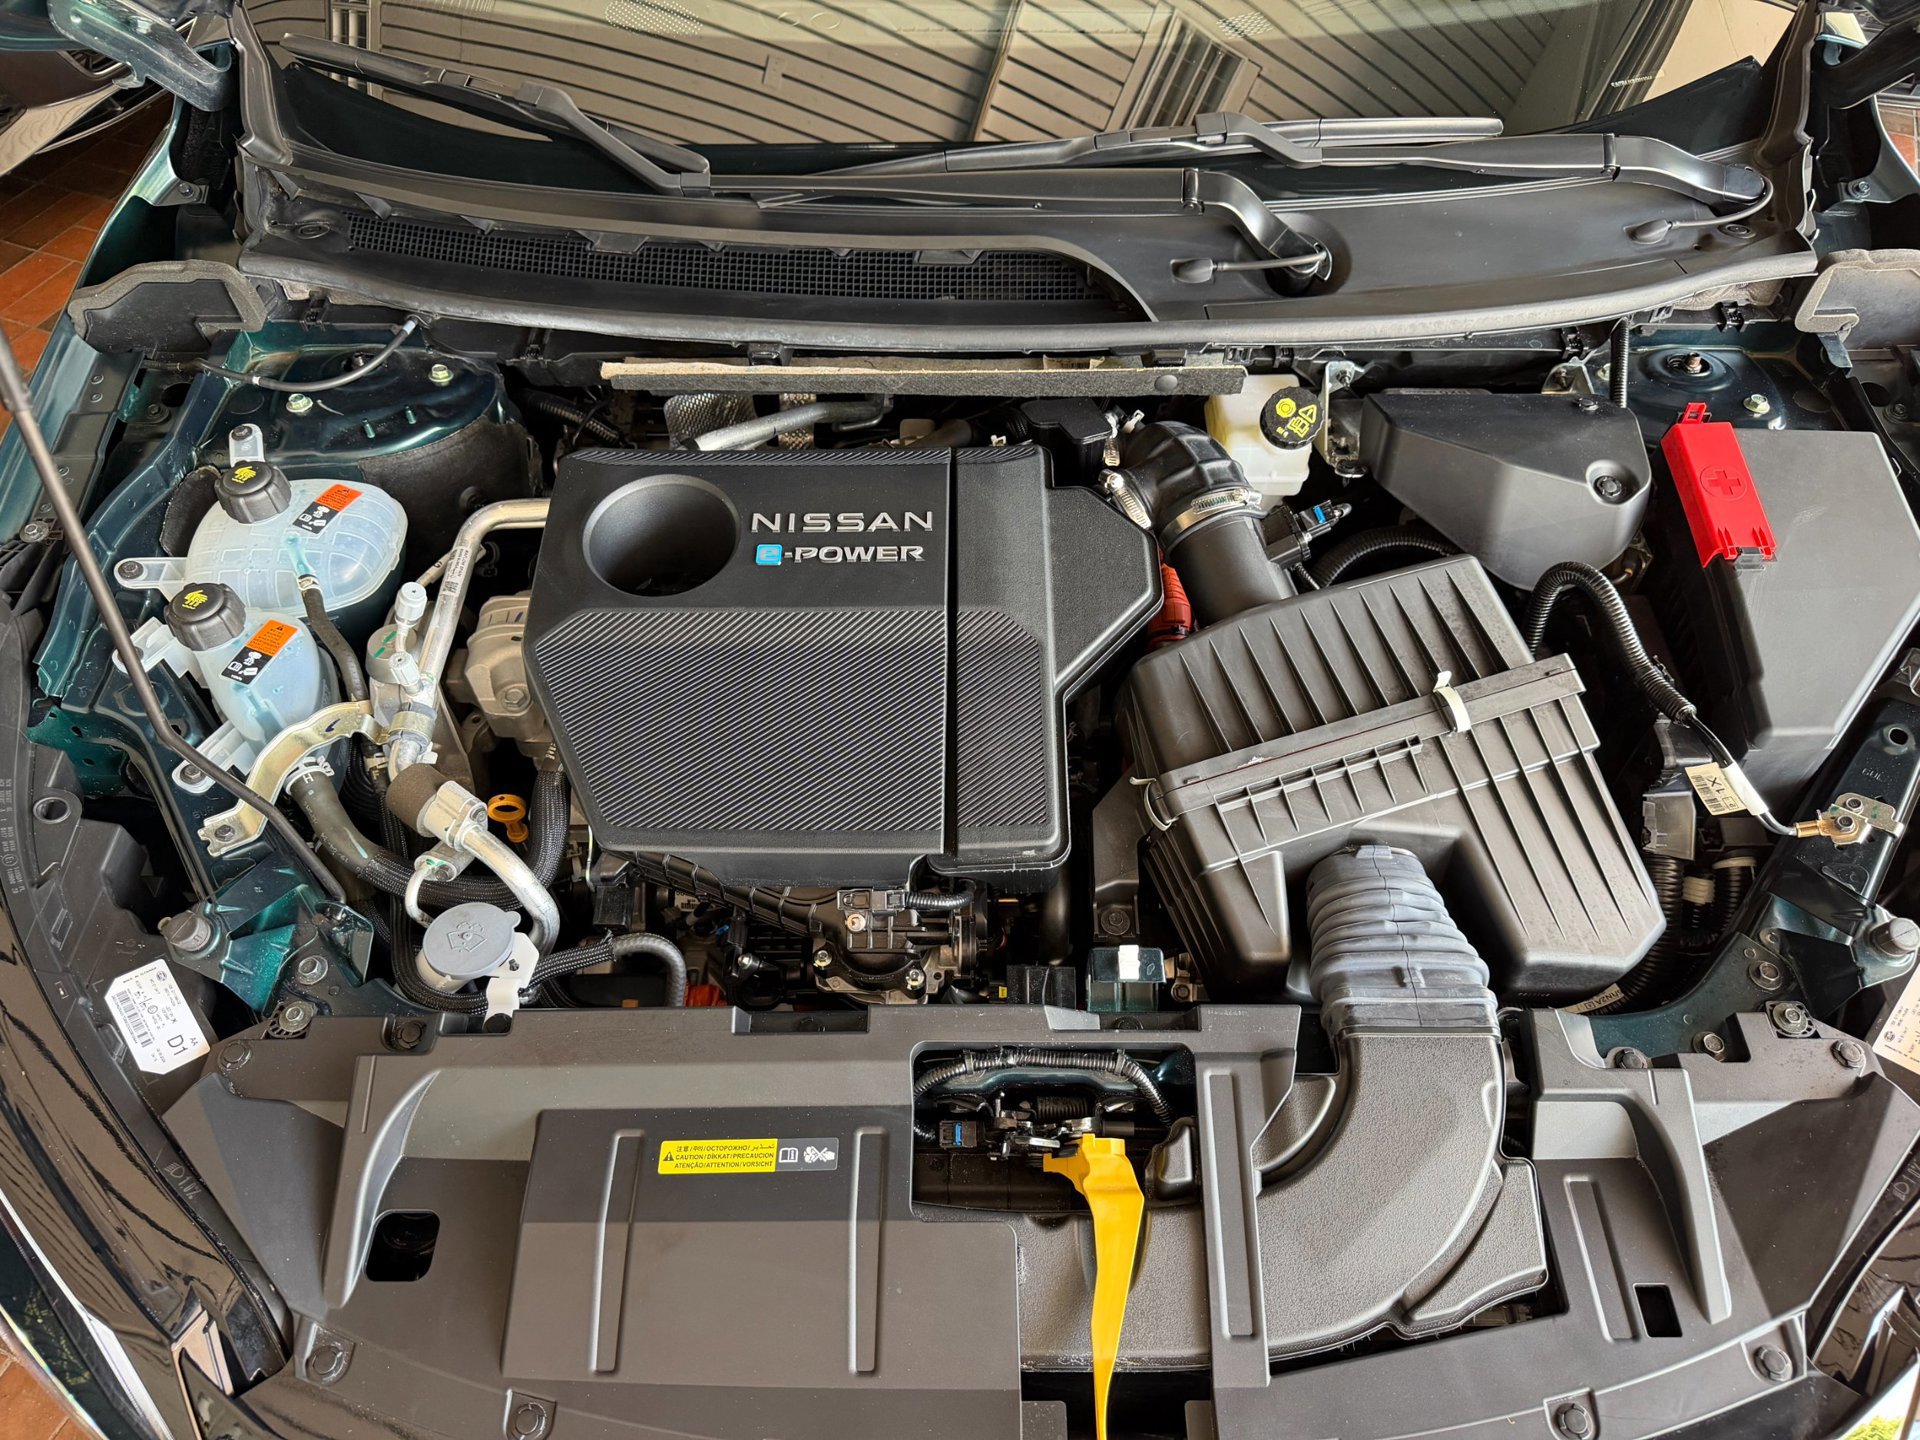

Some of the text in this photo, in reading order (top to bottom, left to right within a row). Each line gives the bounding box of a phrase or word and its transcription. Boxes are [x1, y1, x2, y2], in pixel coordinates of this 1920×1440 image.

[751, 511, 933, 532] NISSAN
[756, 544, 926, 565] e-POWER
[1707, 777, 1725, 794] 1X
[167, 1034, 188, 1056] D1
